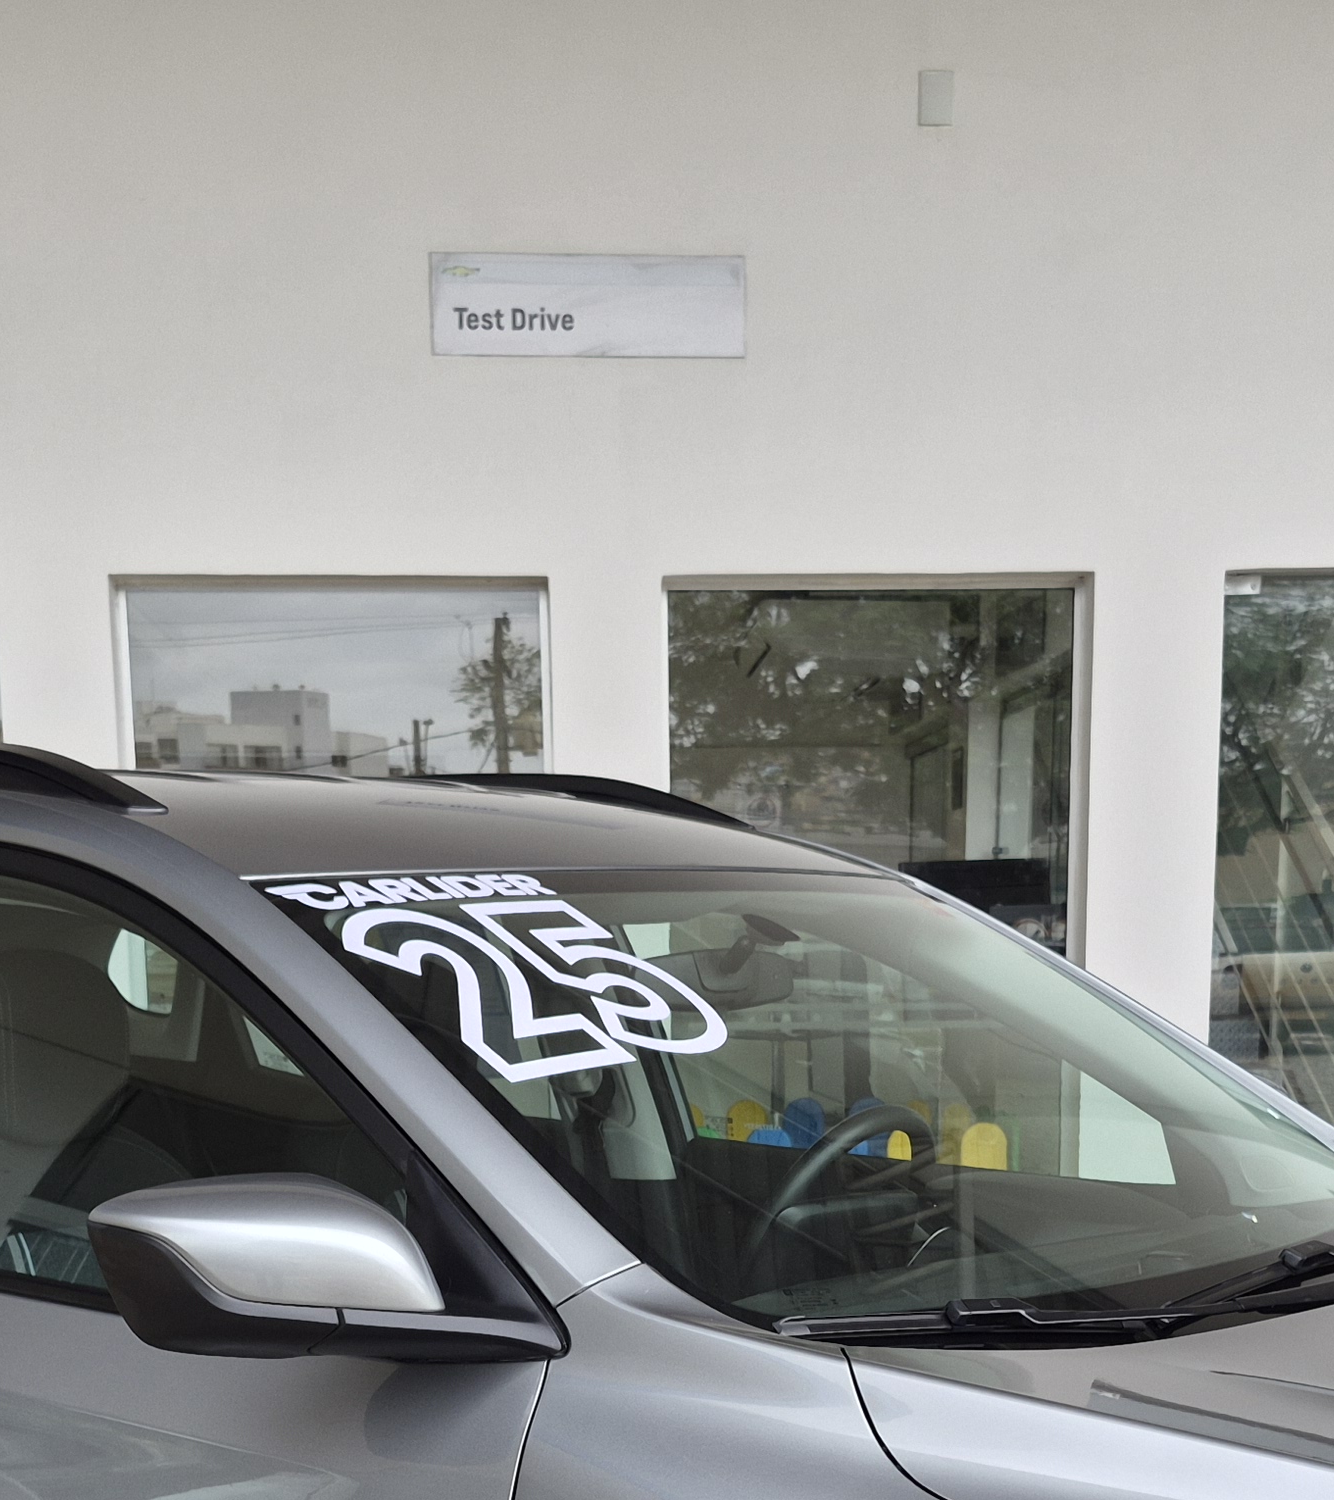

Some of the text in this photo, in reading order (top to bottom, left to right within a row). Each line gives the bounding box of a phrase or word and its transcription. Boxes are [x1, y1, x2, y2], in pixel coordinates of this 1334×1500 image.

[452, 306, 575, 331] Test Drive
[264, 873, 558, 911] CARLIDER
[341, 898, 729, 1084] 25
